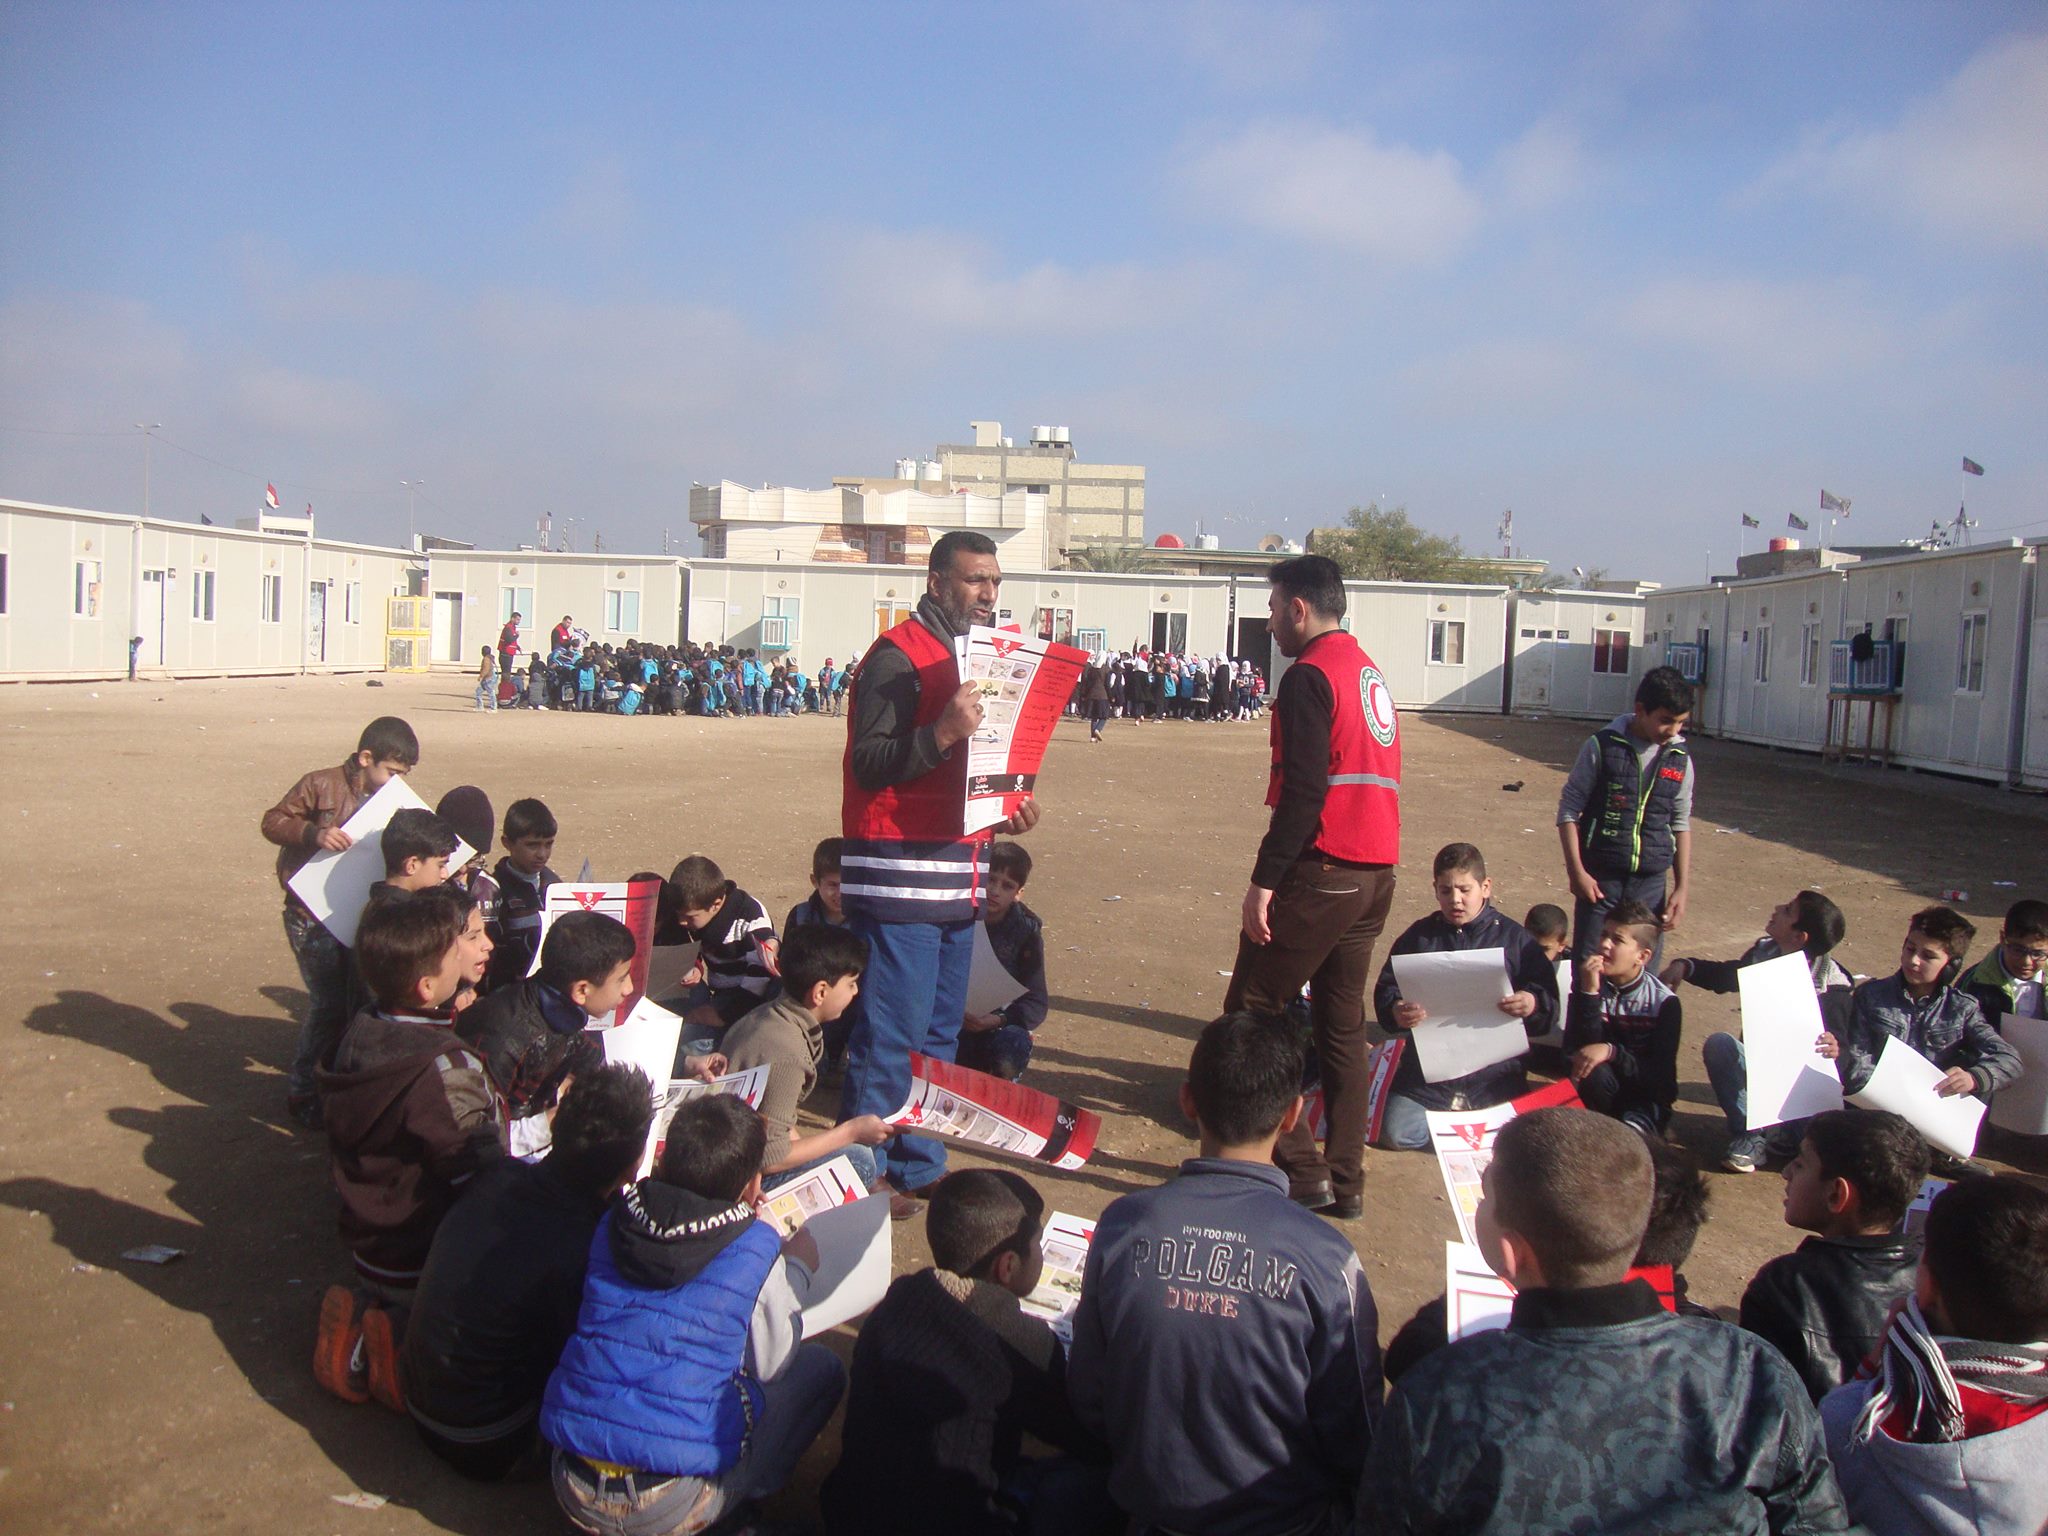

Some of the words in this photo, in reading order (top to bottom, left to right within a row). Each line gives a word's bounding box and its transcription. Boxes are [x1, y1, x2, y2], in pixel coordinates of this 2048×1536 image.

[649, 1219, 685, 1240] LOVE
[689, 1212, 726, 1233] LOVE
[1132, 1236, 1298, 1300] POLGAM
